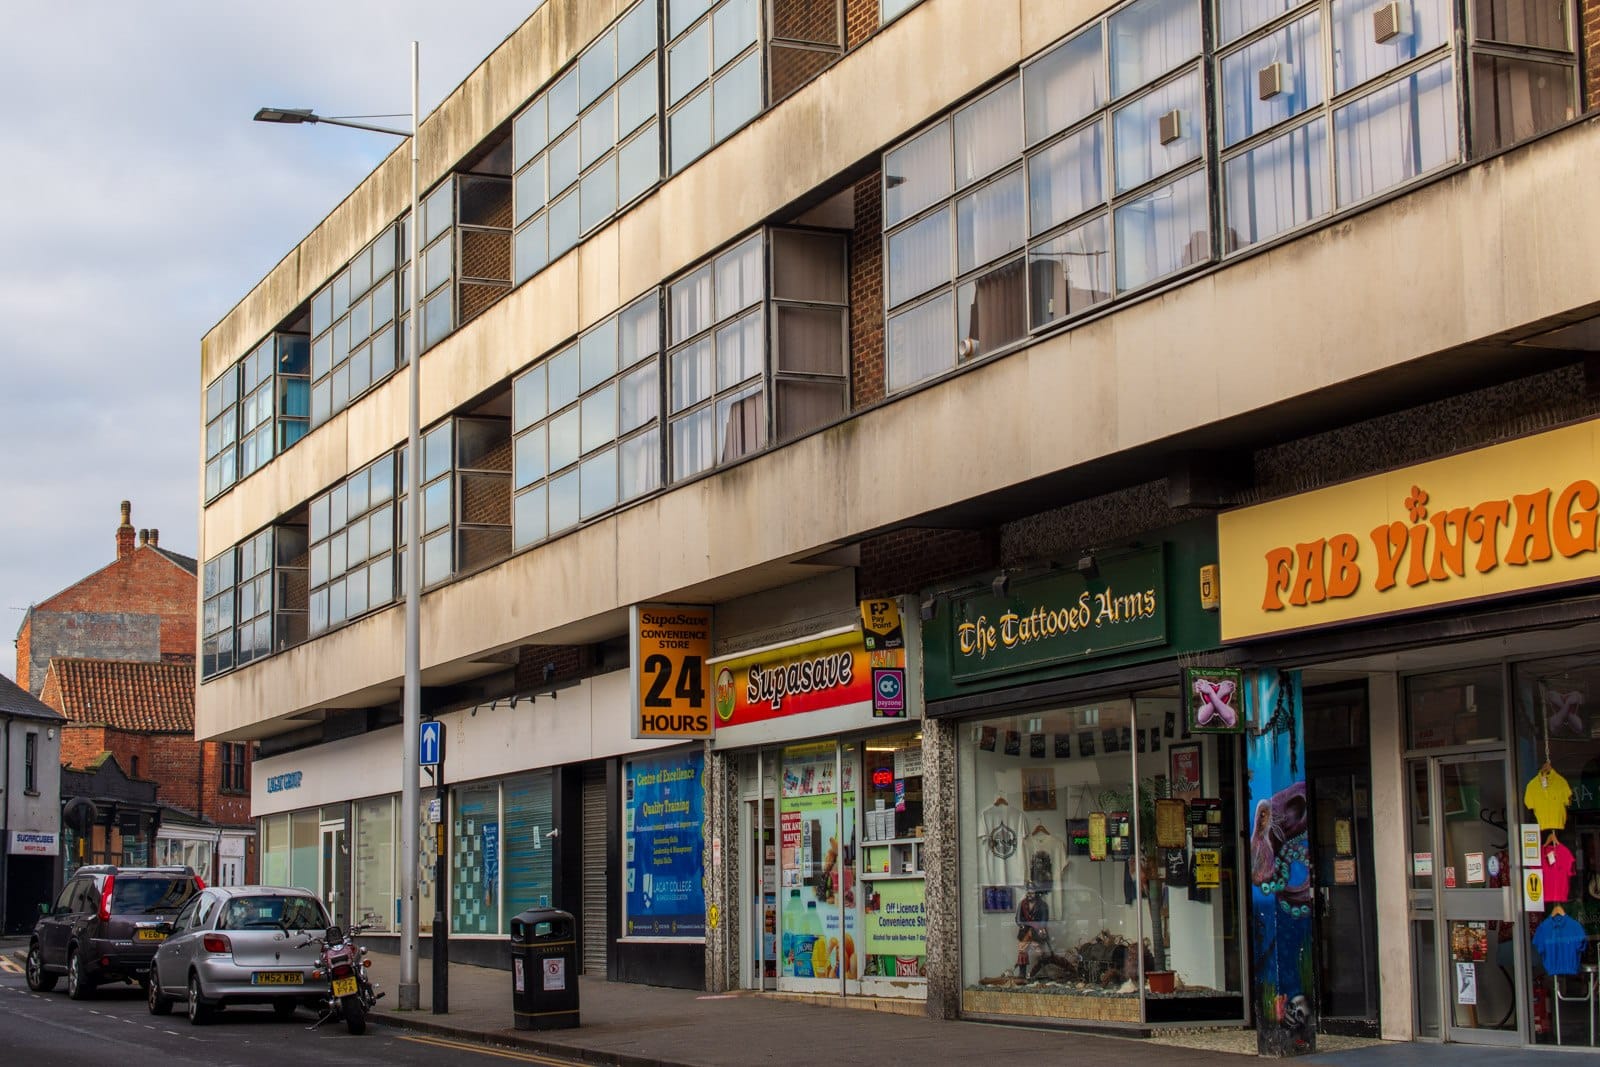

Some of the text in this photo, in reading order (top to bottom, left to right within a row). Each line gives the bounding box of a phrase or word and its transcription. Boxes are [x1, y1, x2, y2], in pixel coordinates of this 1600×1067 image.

[1261, 479, 1600, 612] FAB VINTAG
[641, 613, 709, 627] SupaSave
[872, 615, 885, 624] Pay
[957, 586, 1157, 658] The Tattooed Arms
[641, 630, 707, 640] CONVENIENCE
[658, 640, 690, 649] STORE
[644, 653, 706, 708] 24
[746, 651, 854, 711] Supasave
[877, 700, 902, 708] payzone
[641, 714, 708, 731] HOURS
[637, 773, 655, 787] Centre
[663, 768, 695, 782] Excellence
[873, 771, 893, 785] OPEN
[643, 799, 690, 818] Quality Training
[783, 832, 801, 841] MATCH
[670, 880, 692, 892] COLLEGE
[886, 902, 896, 914] Off
[897, 902, 919, 914] Licence
[878, 916, 916, 927] Convenience
